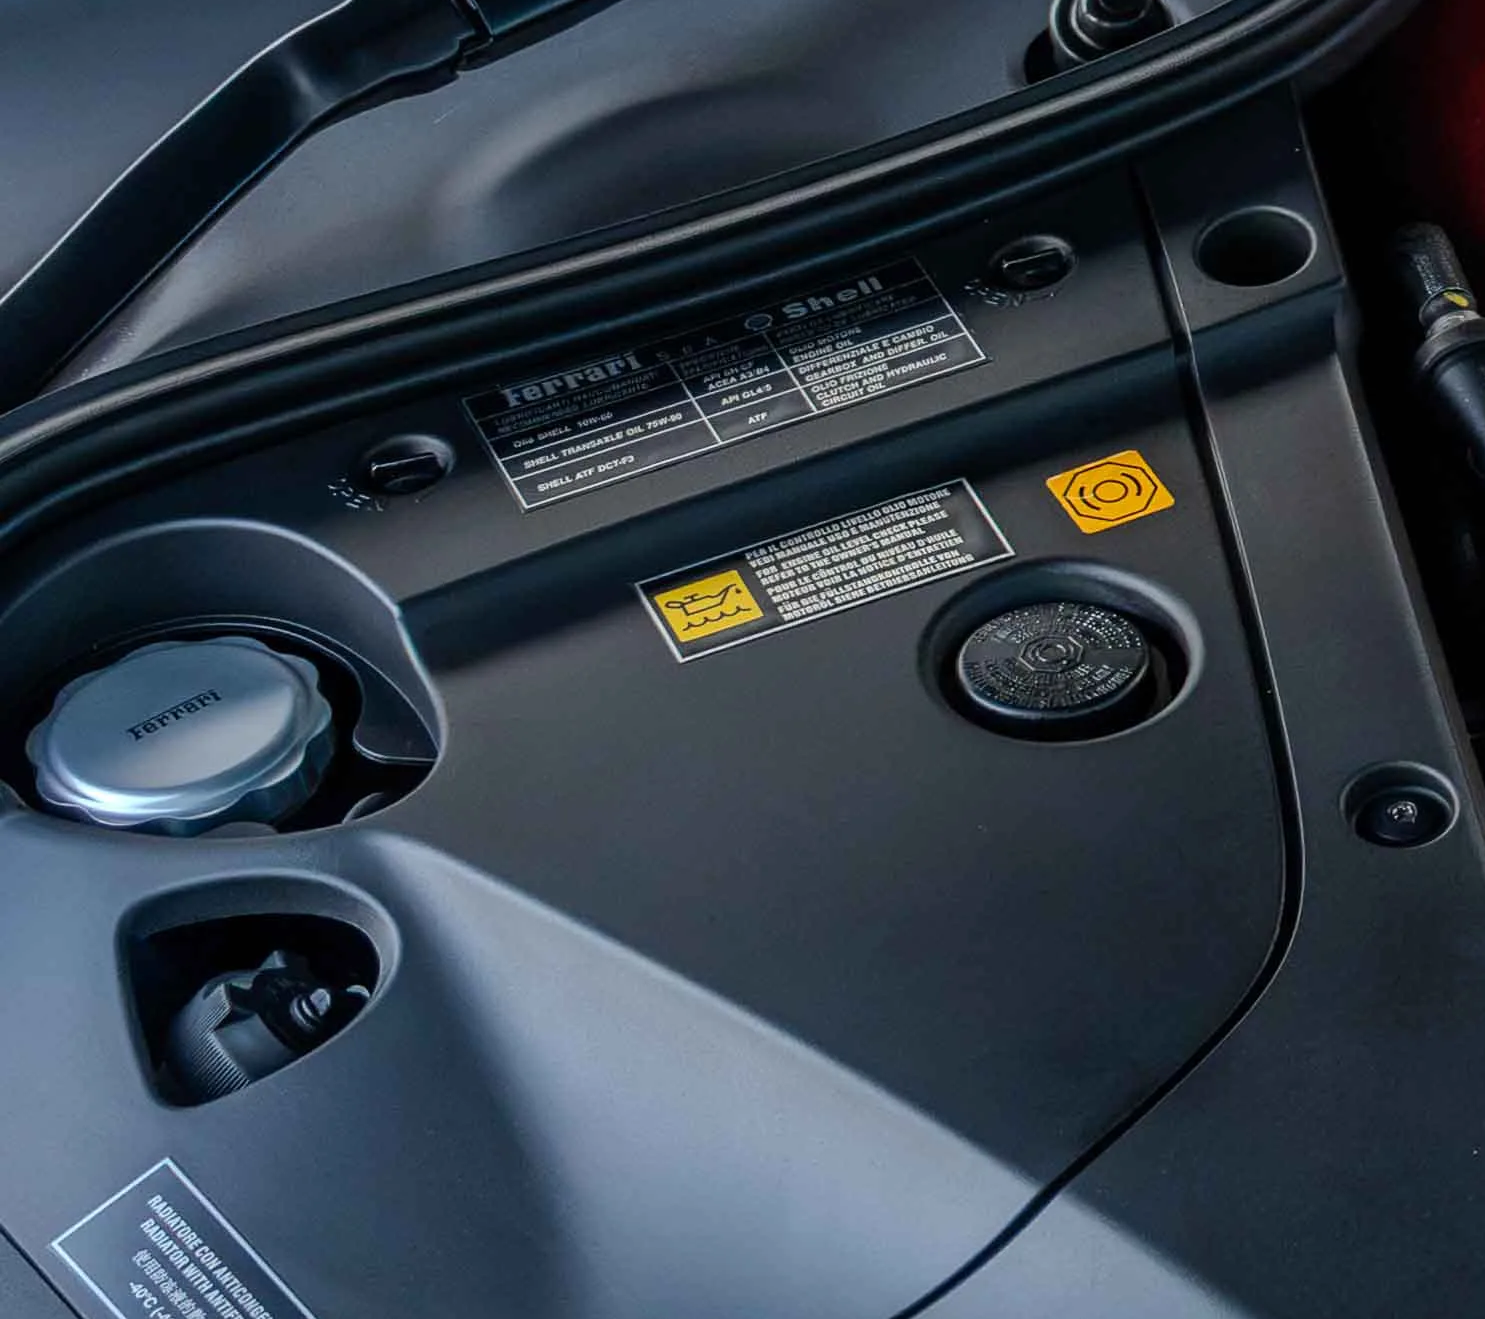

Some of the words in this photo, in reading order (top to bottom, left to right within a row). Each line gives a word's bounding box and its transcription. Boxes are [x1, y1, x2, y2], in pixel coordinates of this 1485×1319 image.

[501, 352, 640, 406] Ferrari
[782, 277, 882, 318] Shell
[792, 345, 832, 362] ENGINE
[798, 342, 879, 373] DIFFERENZIALE
[892, 325, 933, 343] CAMBIO
[805, 360, 856, 381] GEARBOX
[815, 381, 858, 400] CLUTCH
[886, 353, 946, 377] HYDRAULIC
[839, 363, 888, 383] FRIZIONE
[821, 387, 863, 406] CIRCUIT
[775, 538, 827, 559] MANUALE
[858, 501, 940, 531] MANUTENZIONE
[779, 523, 839, 548] CONTROLLO
[840, 509, 881, 528] LIVELLO
[906, 488, 950, 506] MOTORE
[781, 551, 821, 569] ENGINE
[872, 522, 908, 539] CHECK
[907, 510, 947, 527] PLEASE
[879, 527, 925, 546] MANUAL
[876, 541, 915, 558] NIVEAU
[771, 583, 816, 602] MOTEUR
[857, 557, 896, 575] NOTICE
[126, 689, 222, 741] Ferrari
[140, 1218, 188, 1268] RADIATOR
[182, 1263, 212, 1293] WITH
[147, 1195, 201, 1249] RADIATORE
[194, 1245, 221, 1269] CON
